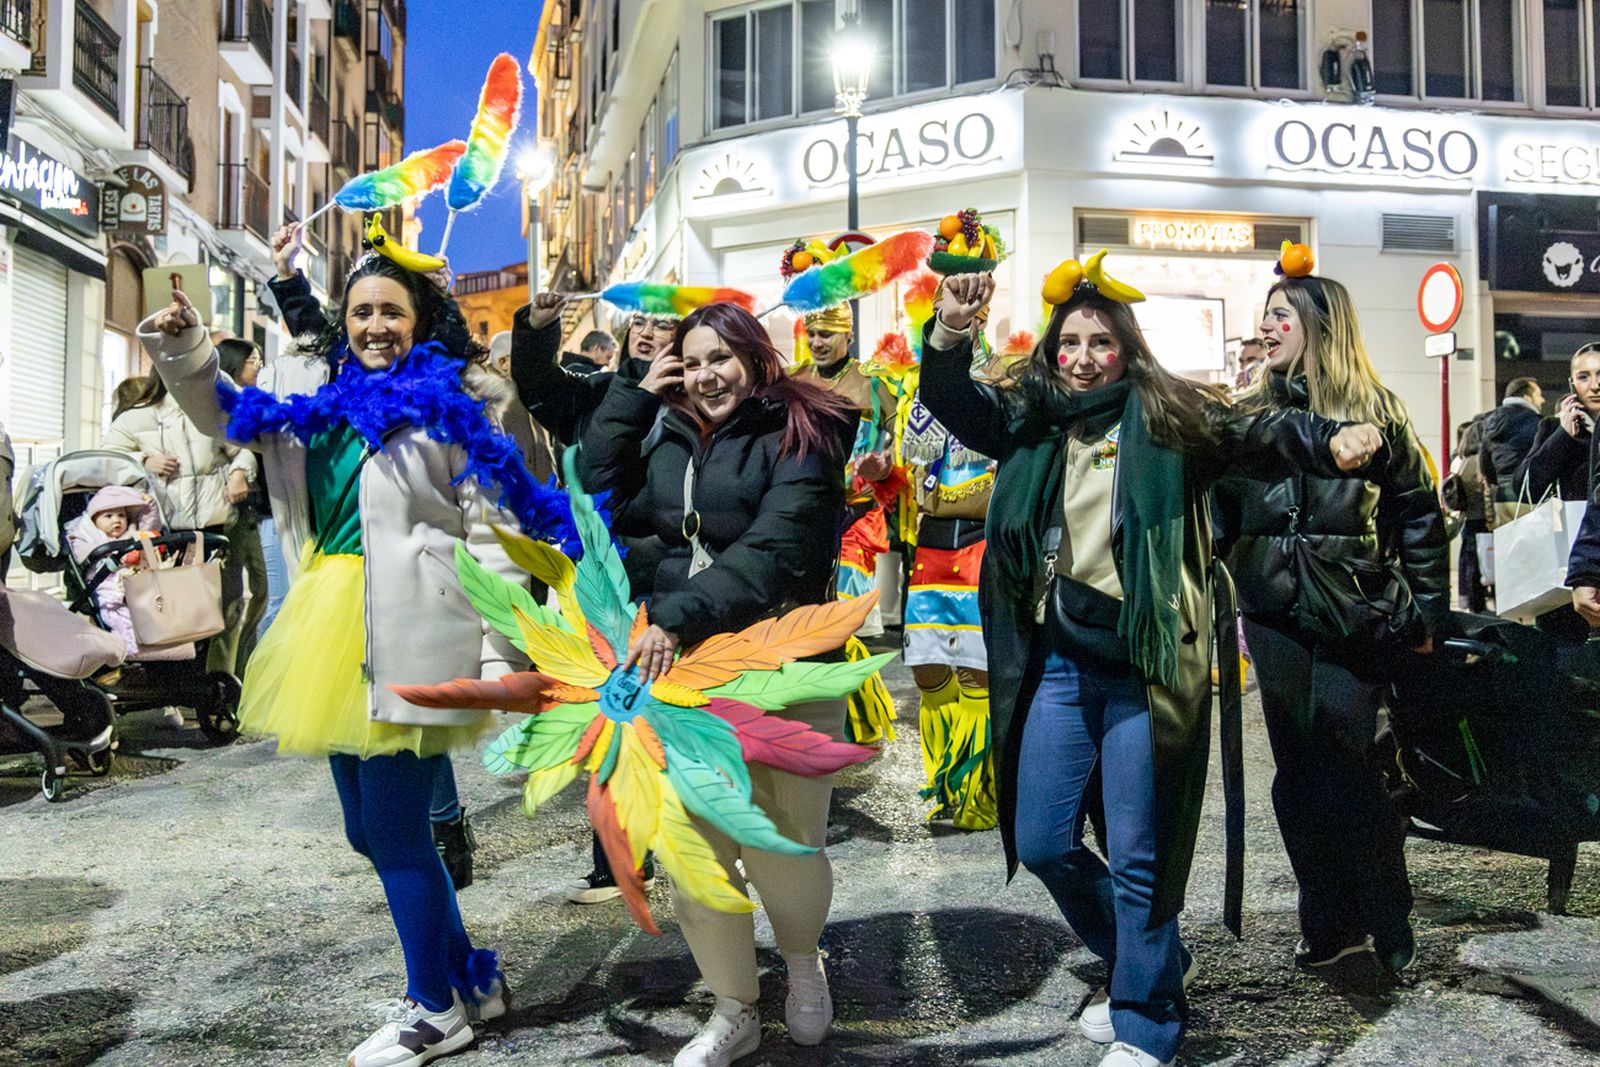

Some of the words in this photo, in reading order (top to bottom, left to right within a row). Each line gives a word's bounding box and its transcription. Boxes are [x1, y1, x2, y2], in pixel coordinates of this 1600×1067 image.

[803, 112, 995, 183] OCASO
[1274, 119, 1478, 174] OCASO
[1514, 143, 1600, 180] SEG
[133, 167, 159, 189] LAS
[147, 194, 162, 230] TAPAS
[1140, 222, 1250, 243] PRONOVIAS
